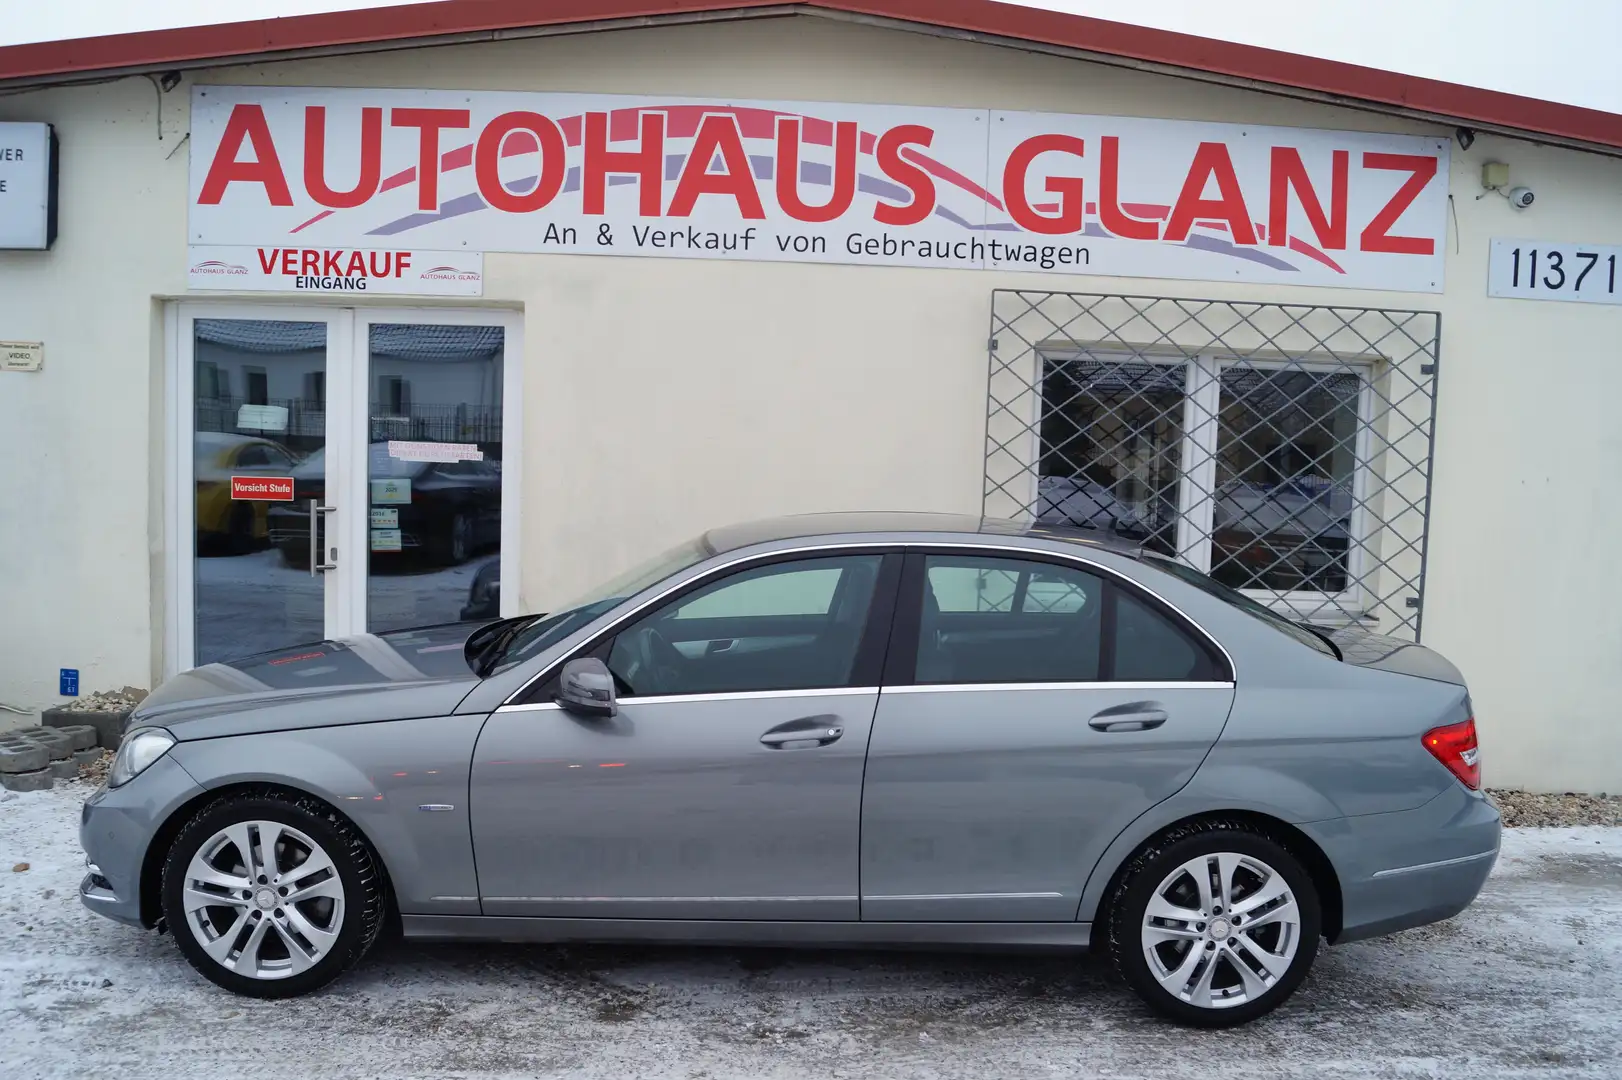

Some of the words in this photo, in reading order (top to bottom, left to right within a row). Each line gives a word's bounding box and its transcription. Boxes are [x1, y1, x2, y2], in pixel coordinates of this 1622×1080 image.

[197, 104, 936, 226] AUTOHAUS
[1003, 134, 1438, 255] GLANZ
[257, 248, 412, 278] VERKAUF
[543, 223, 577, 244] An
[597, 223, 613, 246] &
[632, 225, 756, 250] Verkauf
[776, 235, 826, 253] von
[846, 233, 1090, 269] Gebrauchtwagen
[296, 276, 367, 290] EINGANG
[1512, 248, 1615, 293] 11371
[234, 483, 268, 492] Vorsicht
[269, 483, 291, 493] Stufe
